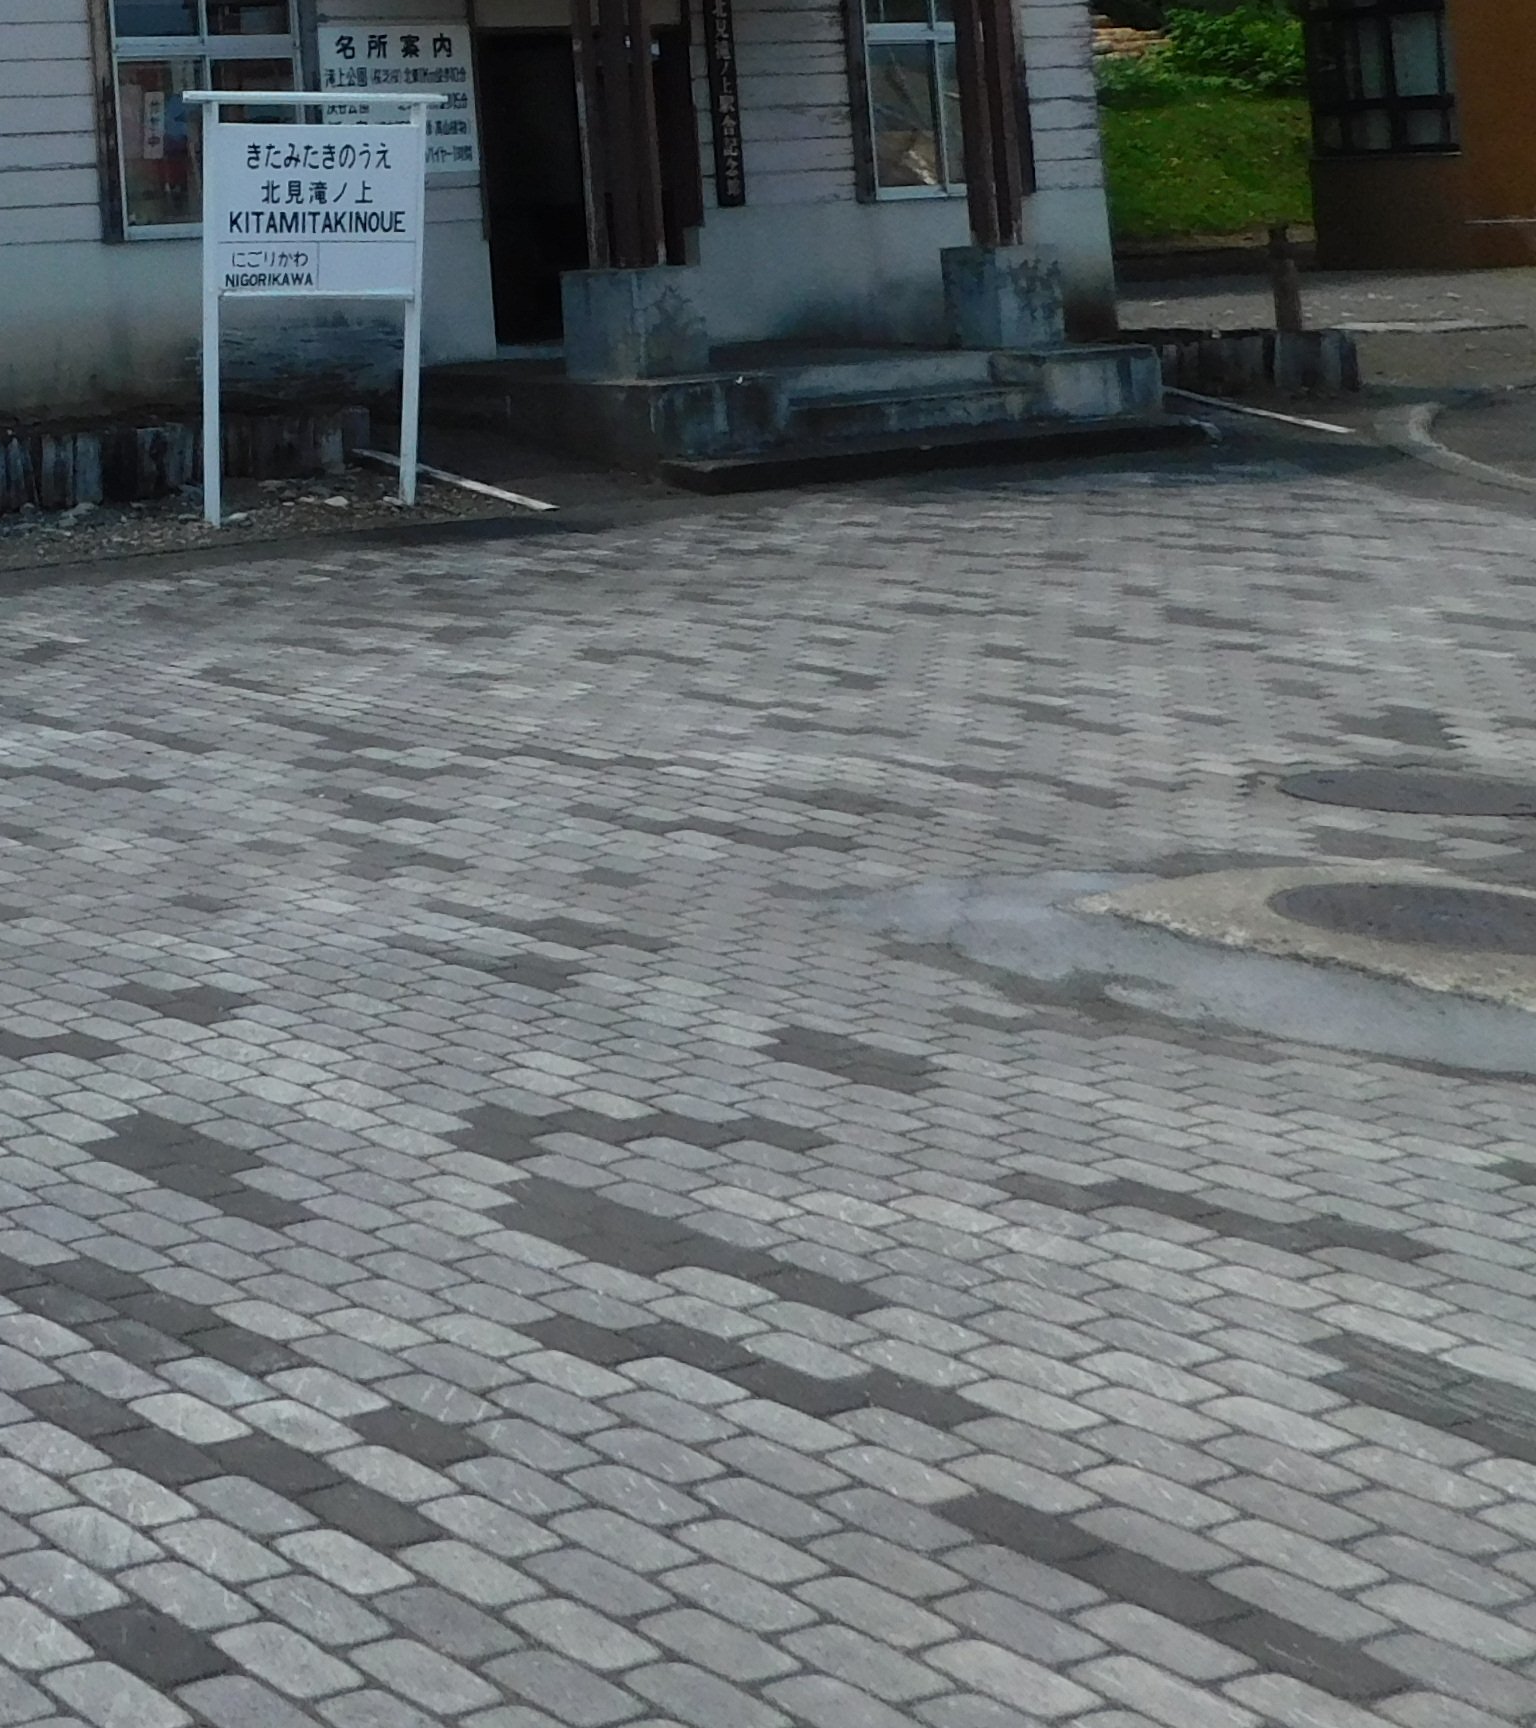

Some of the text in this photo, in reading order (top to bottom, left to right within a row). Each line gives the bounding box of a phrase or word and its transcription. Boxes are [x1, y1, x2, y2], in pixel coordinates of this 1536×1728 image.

[335, 32, 453, 60] 名所案内
[324, 67, 368, 87] 滝上公園
[246, 142, 391, 169] きたみたきのうえ
[261, 180, 374, 204] 北見滝ノ上
[229, 211, 406, 234] KITAMITAKINOUE
[231, 250, 308, 268] にごりかわ
[225, 273, 313, 288] NIGORIKAWA
